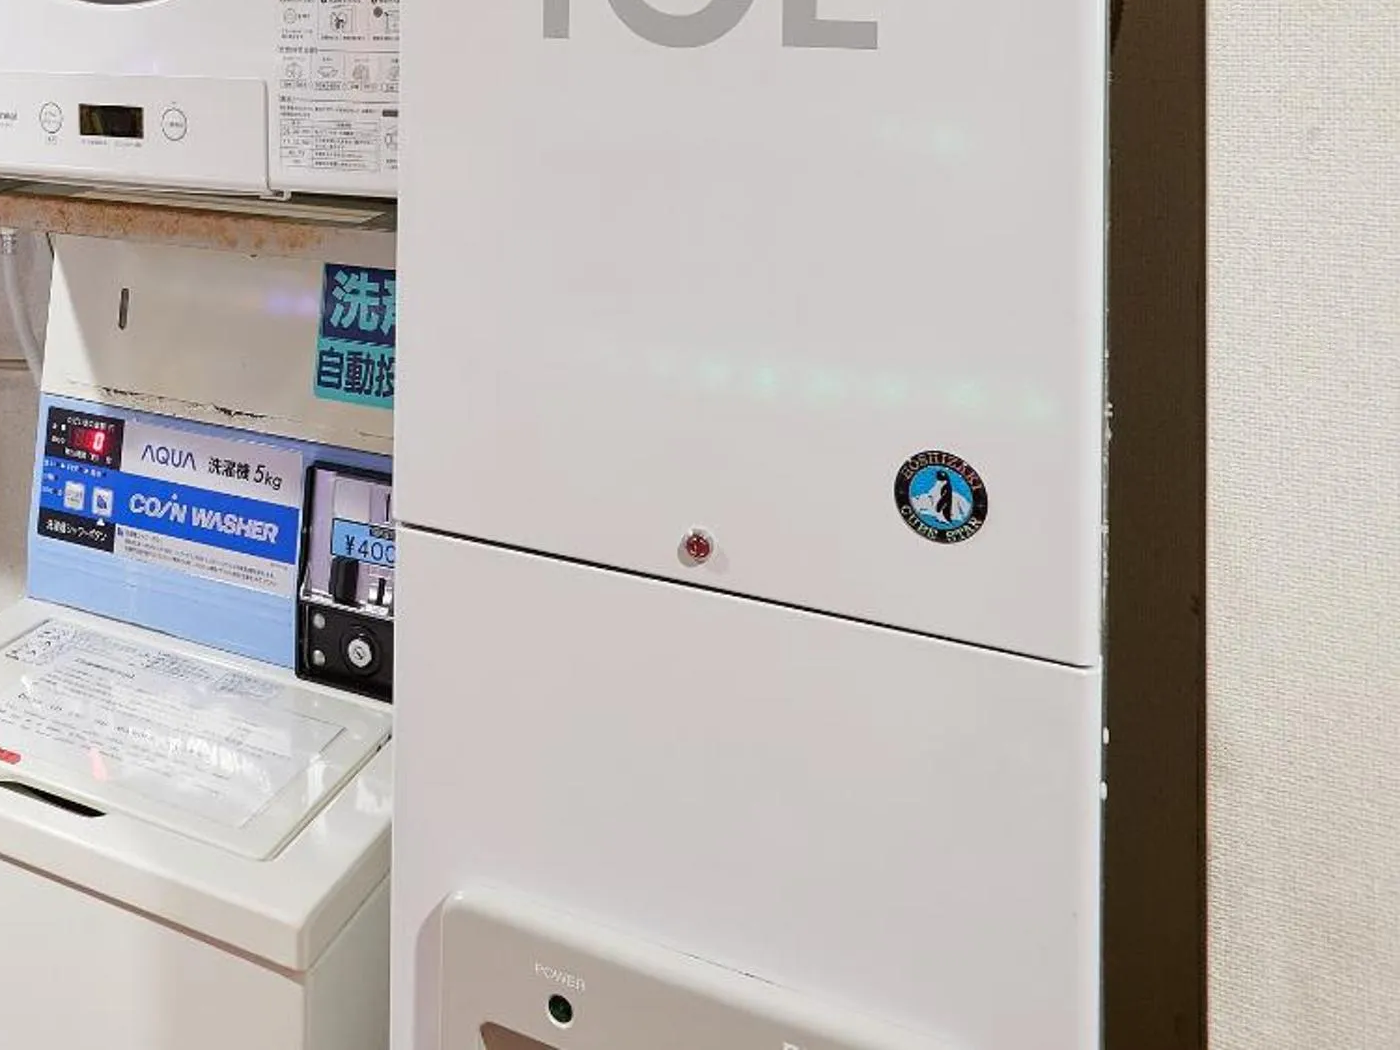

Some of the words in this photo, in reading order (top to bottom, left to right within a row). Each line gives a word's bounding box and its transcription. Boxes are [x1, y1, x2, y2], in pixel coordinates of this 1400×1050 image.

[141, 444, 197, 471] AQUA
[191, 507, 280, 544] WASHER
[535, 962, 586, 991] POWER
